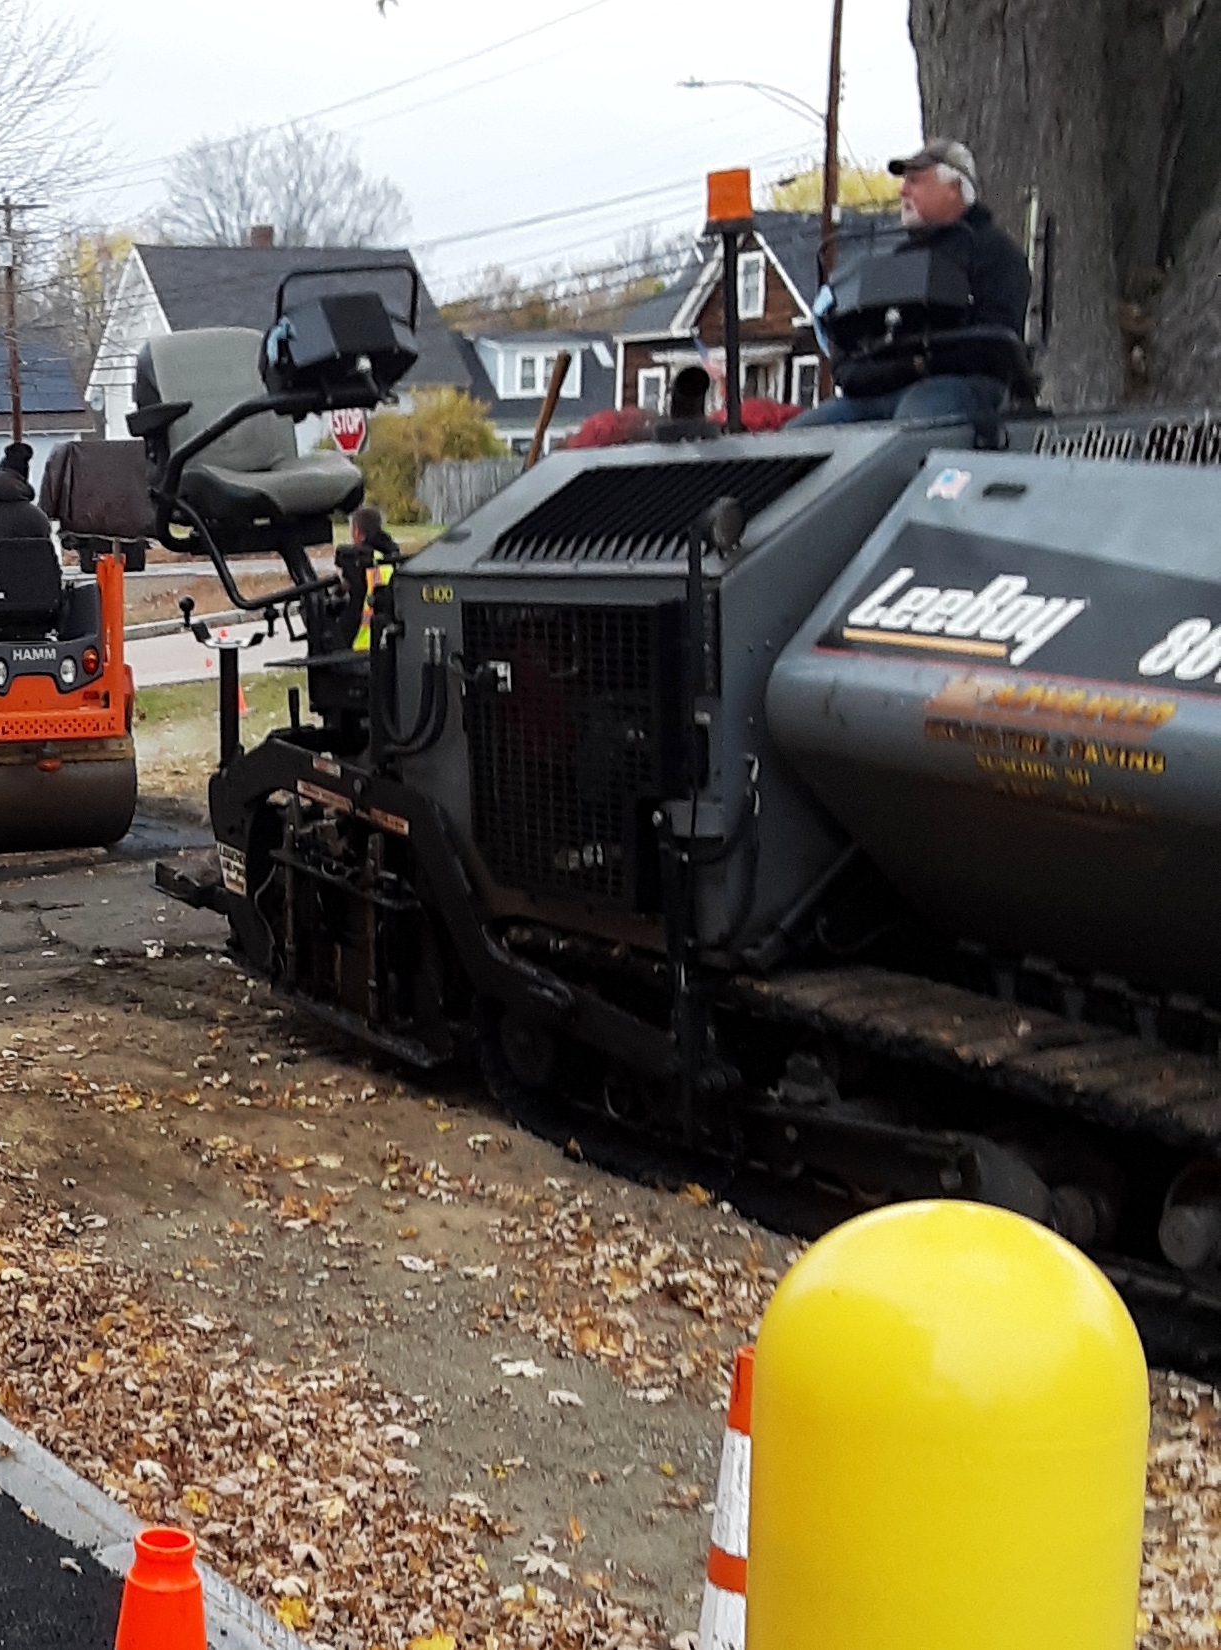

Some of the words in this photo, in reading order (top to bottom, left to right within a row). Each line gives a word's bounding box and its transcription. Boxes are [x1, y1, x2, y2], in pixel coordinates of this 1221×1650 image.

[333, 408, 362, 434] STOP
[847, 567, 1087, 666] LeeBoy
[12, 648, 57, 660] HAMM
